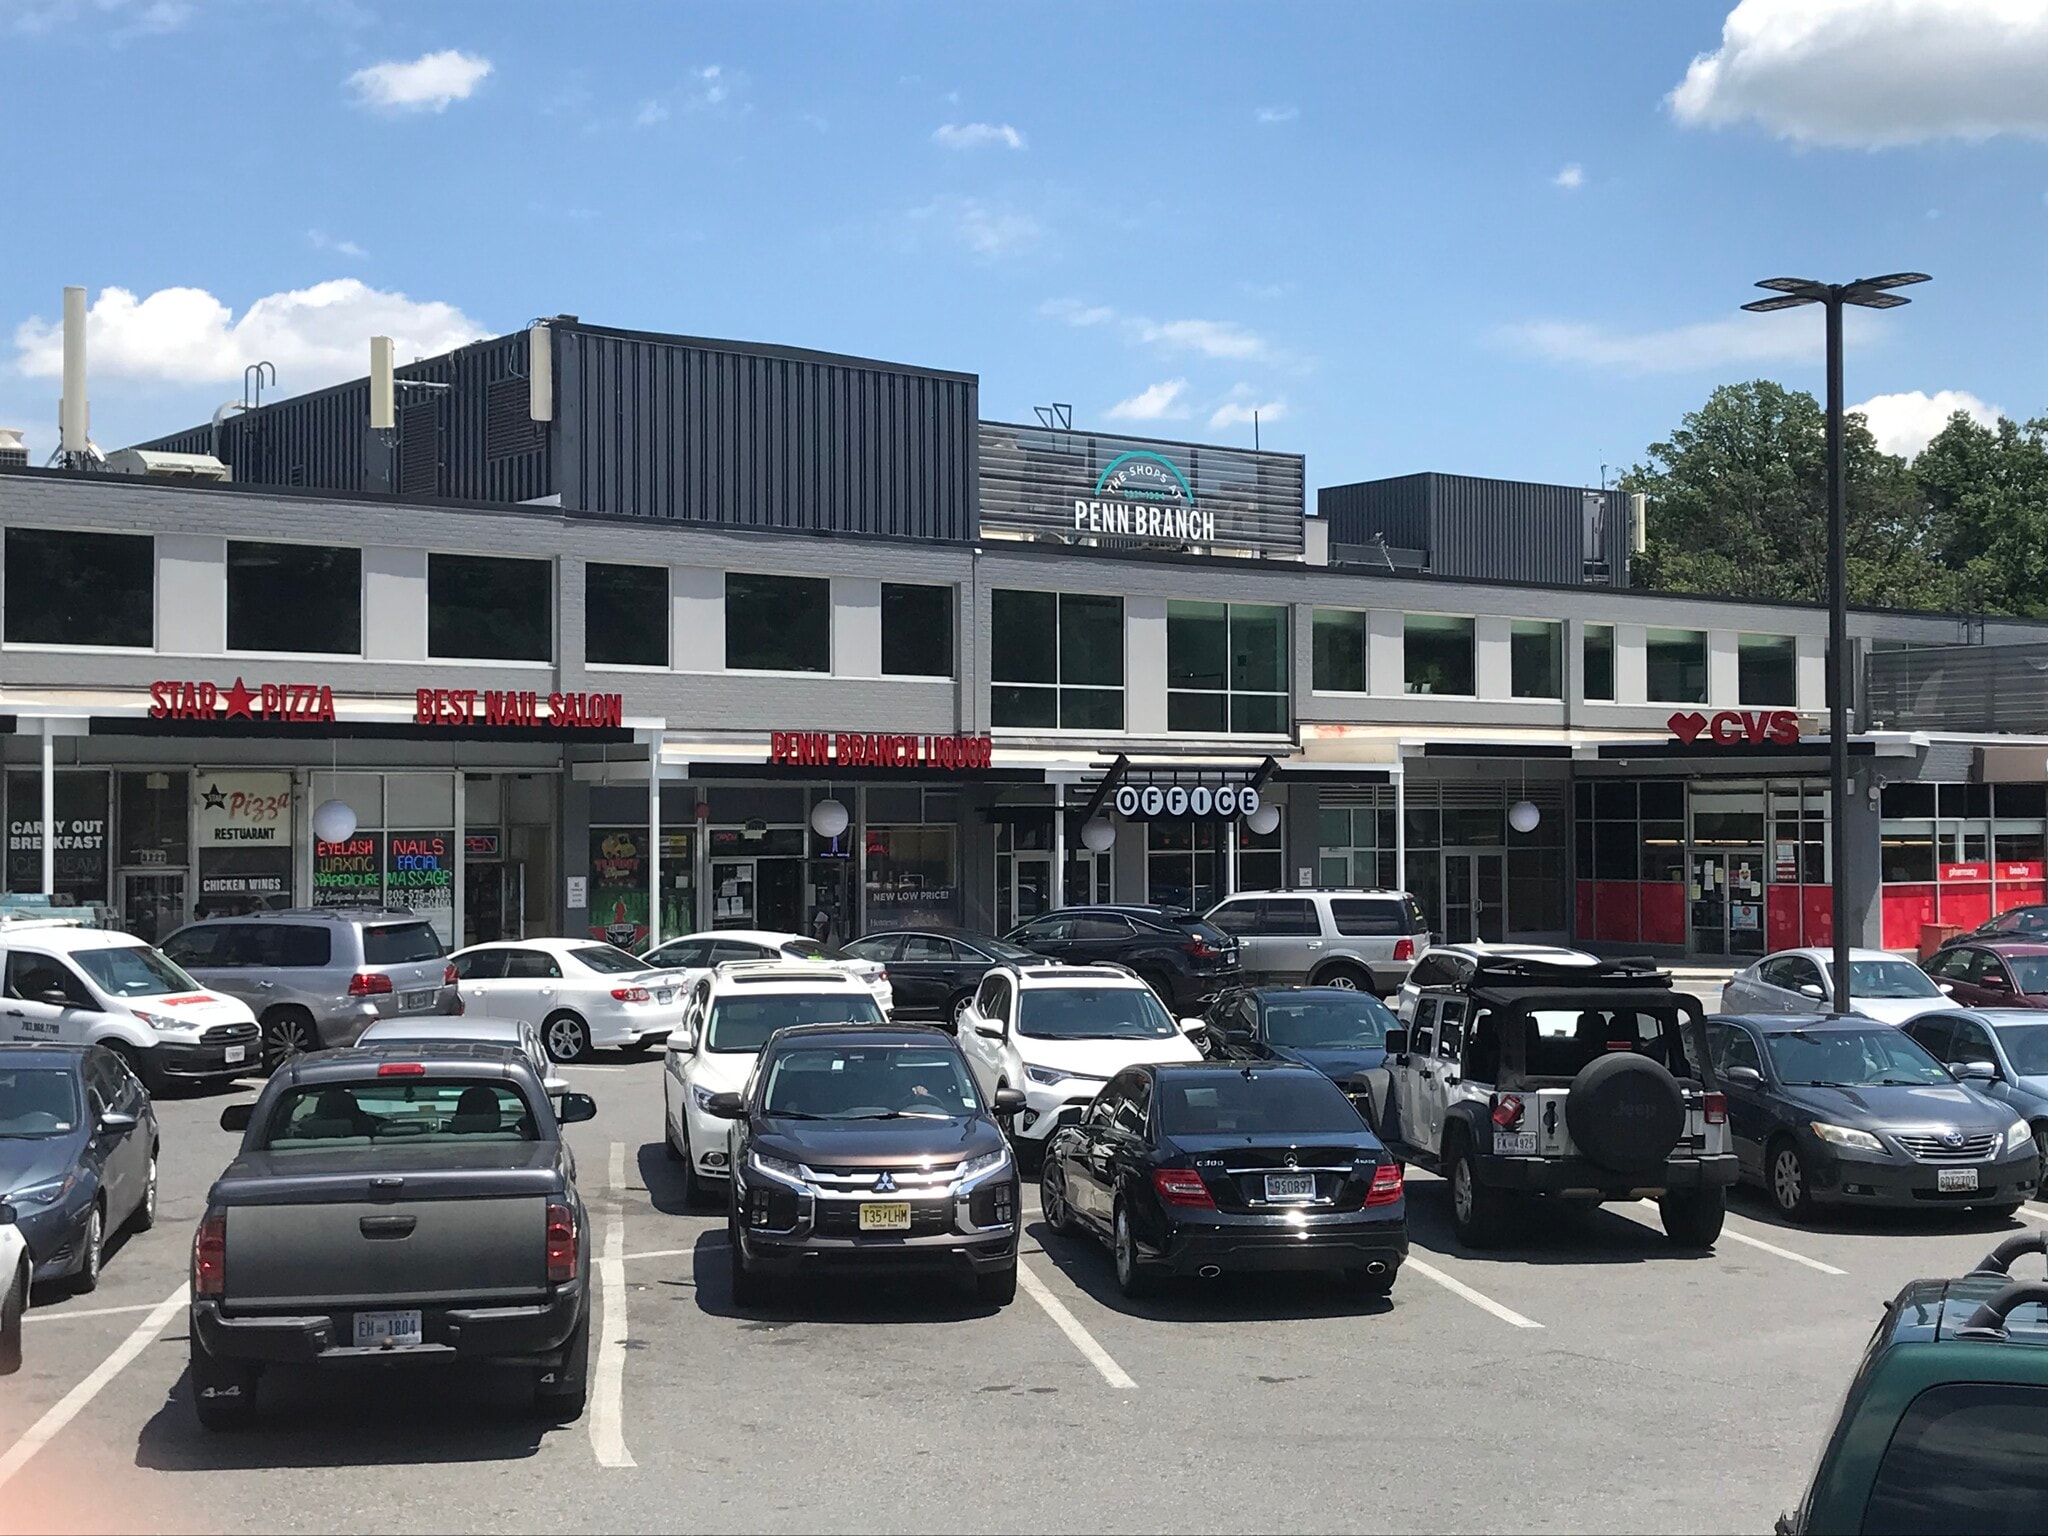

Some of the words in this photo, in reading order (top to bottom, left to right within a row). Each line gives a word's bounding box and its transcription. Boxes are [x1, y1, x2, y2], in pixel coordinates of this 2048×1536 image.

[1106, 471, 1127, 495] THE
[1129, 464, 1168, 483] SHOPS
[1168, 484, 1183, 500] AT
[1074, 500, 1129, 534] PENN
[1135, 505, 1215, 541] BRANCH
[150, 680, 217, 719] STAR
[261, 683, 335, 722] PIZZA
[416, 688, 478, 726] BEST
[484, 690, 542, 727] NAIL
[548, 692, 622, 728] SALON
[1710, 710, 1799, 745] CVS
[771, 731, 829, 766] PENN
[836, 733, 918, 768] BRANCH
[925, 736, 991, 770] LIQUOR
[229, 791, 290, 822] Pizza
[1118, 788, 1257, 813] OFFICE
[11, 820, 66, 835] CARY
[72, 820, 104, 834] OUT
[214, 827, 276, 841] RESTUARANT
[10, 836, 103, 850] BREKFAST
[317, 840, 373, 856] EYELASH
[393, 838, 445, 855] NAILS
[465, 838, 497, 852] PEN
[320, 856, 374, 872] WAXING
[397, 855, 441, 871] FACIAL
[387, 870, 451, 886] MASSAGE
[1948, 866, 1979, 878] pharmacy
[203, 879, 246, 892] CHICKEN
[249, 878, 282, 891] WINGS
[873, 893, 895, 902] NEW
[897, 892, 919, 901] LOW
[920, 891, 949, 900] PRICE!
